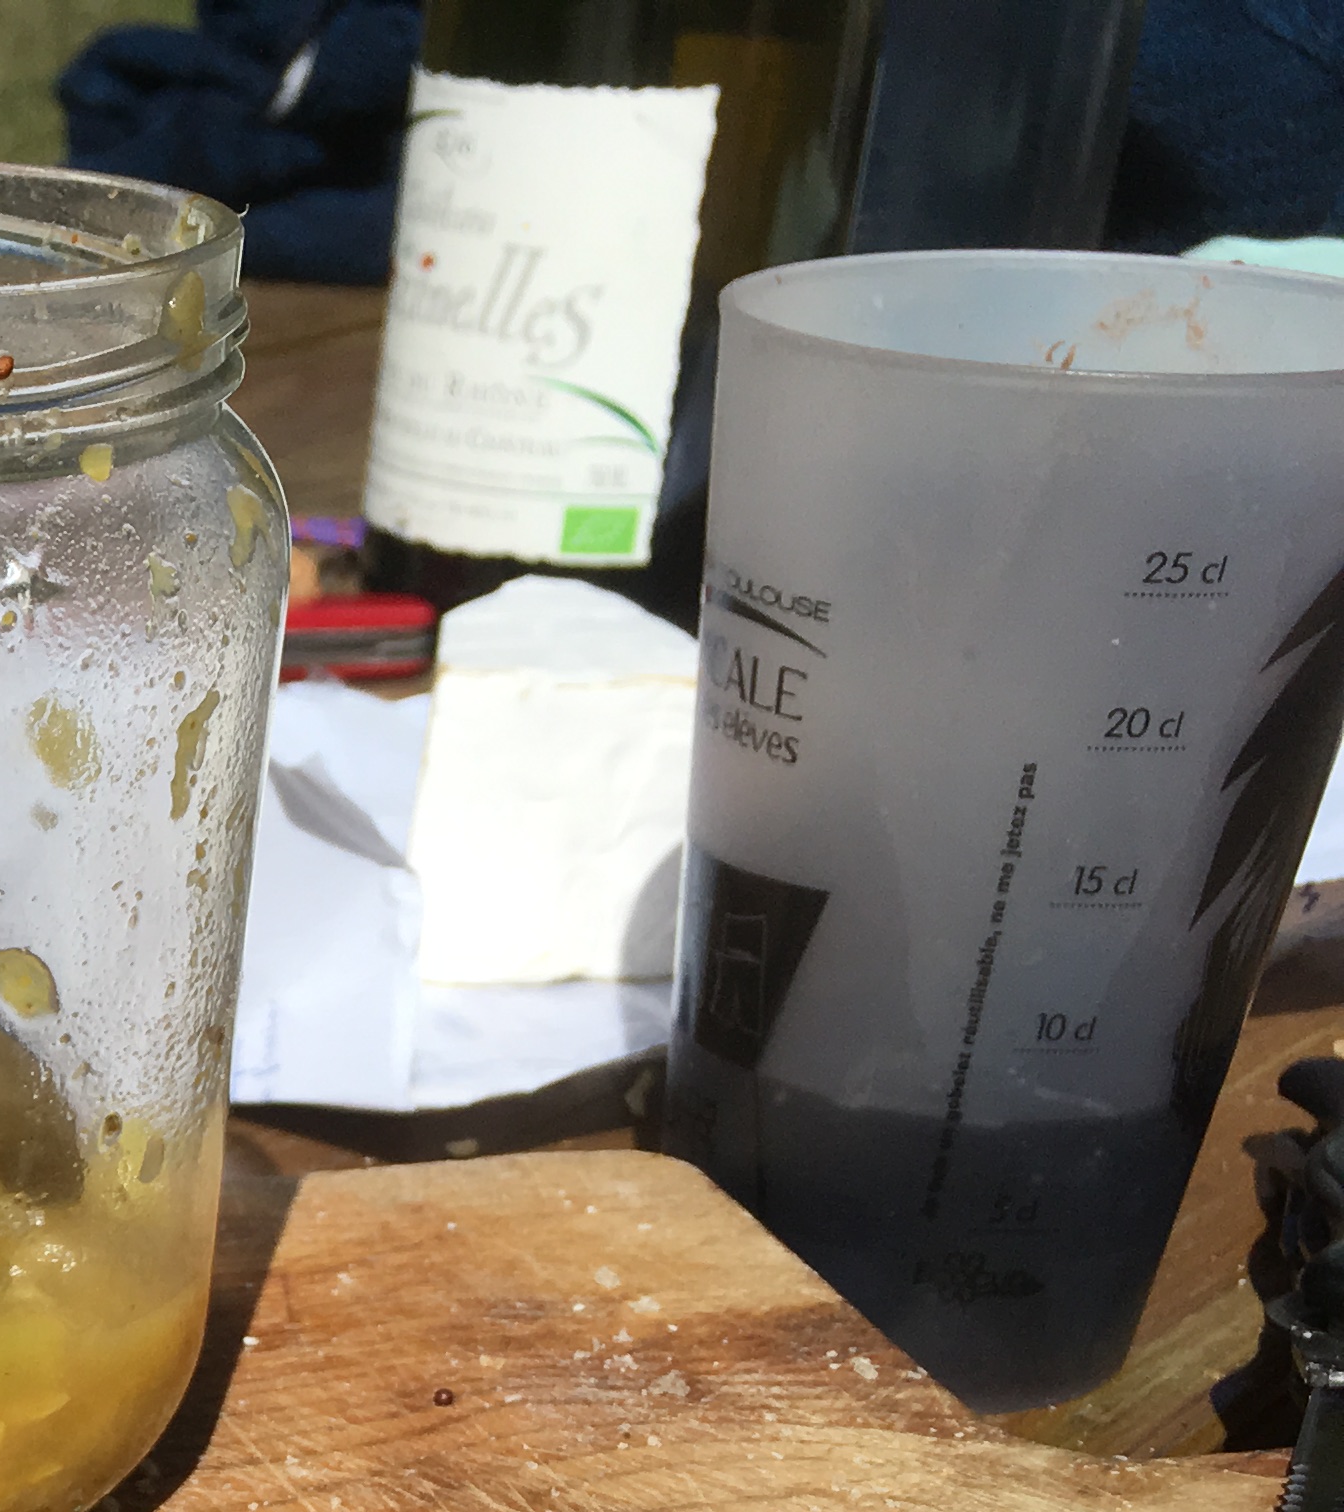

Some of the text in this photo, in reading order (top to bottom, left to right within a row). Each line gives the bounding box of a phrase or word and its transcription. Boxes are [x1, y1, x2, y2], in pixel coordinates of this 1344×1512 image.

[1142, 551, 1228, 584] 25 cl
[709, 634, 808, 722] CALE
[1104, 706, 1185, 738] 20 cl
[1000, 805, 1028, 859] jetez
[1018, 761, 1038, 799] pas
[1073, 864, 1139, 896] 15 cl
[1036, 1011, 1098, 1042] 10 cl
